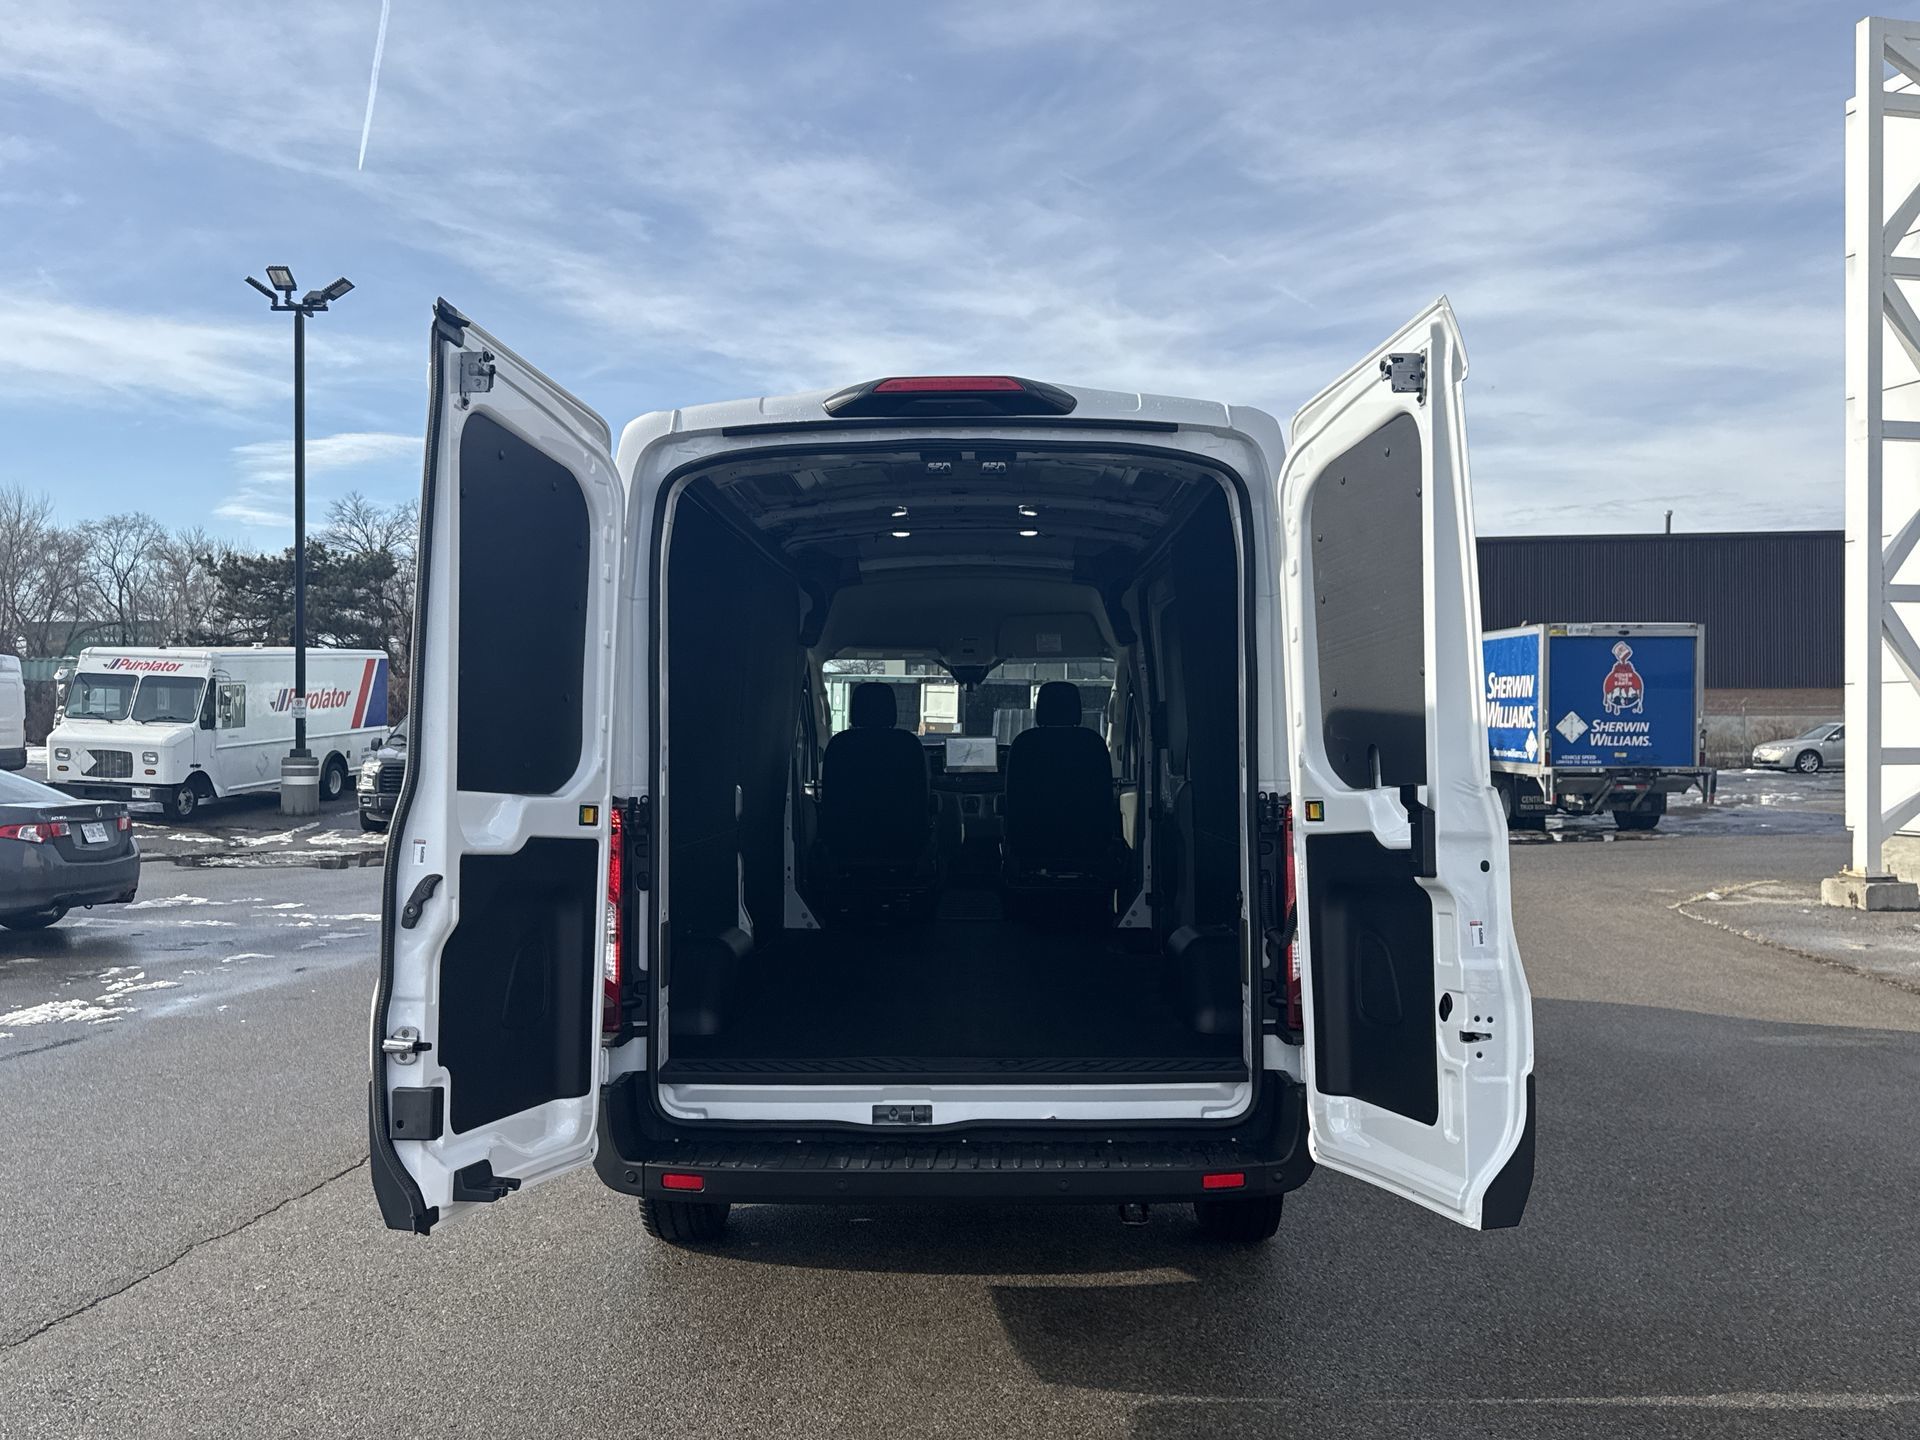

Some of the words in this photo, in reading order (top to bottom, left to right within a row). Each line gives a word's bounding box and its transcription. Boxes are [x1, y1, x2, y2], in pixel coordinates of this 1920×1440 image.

[116, 658, 184, 672] Purolator
[1487, 671, 1535, 699] SHERWIN
[285, 687, 352, 712] Prolator
[1591, 719, 1650, 733] SHERWIN
